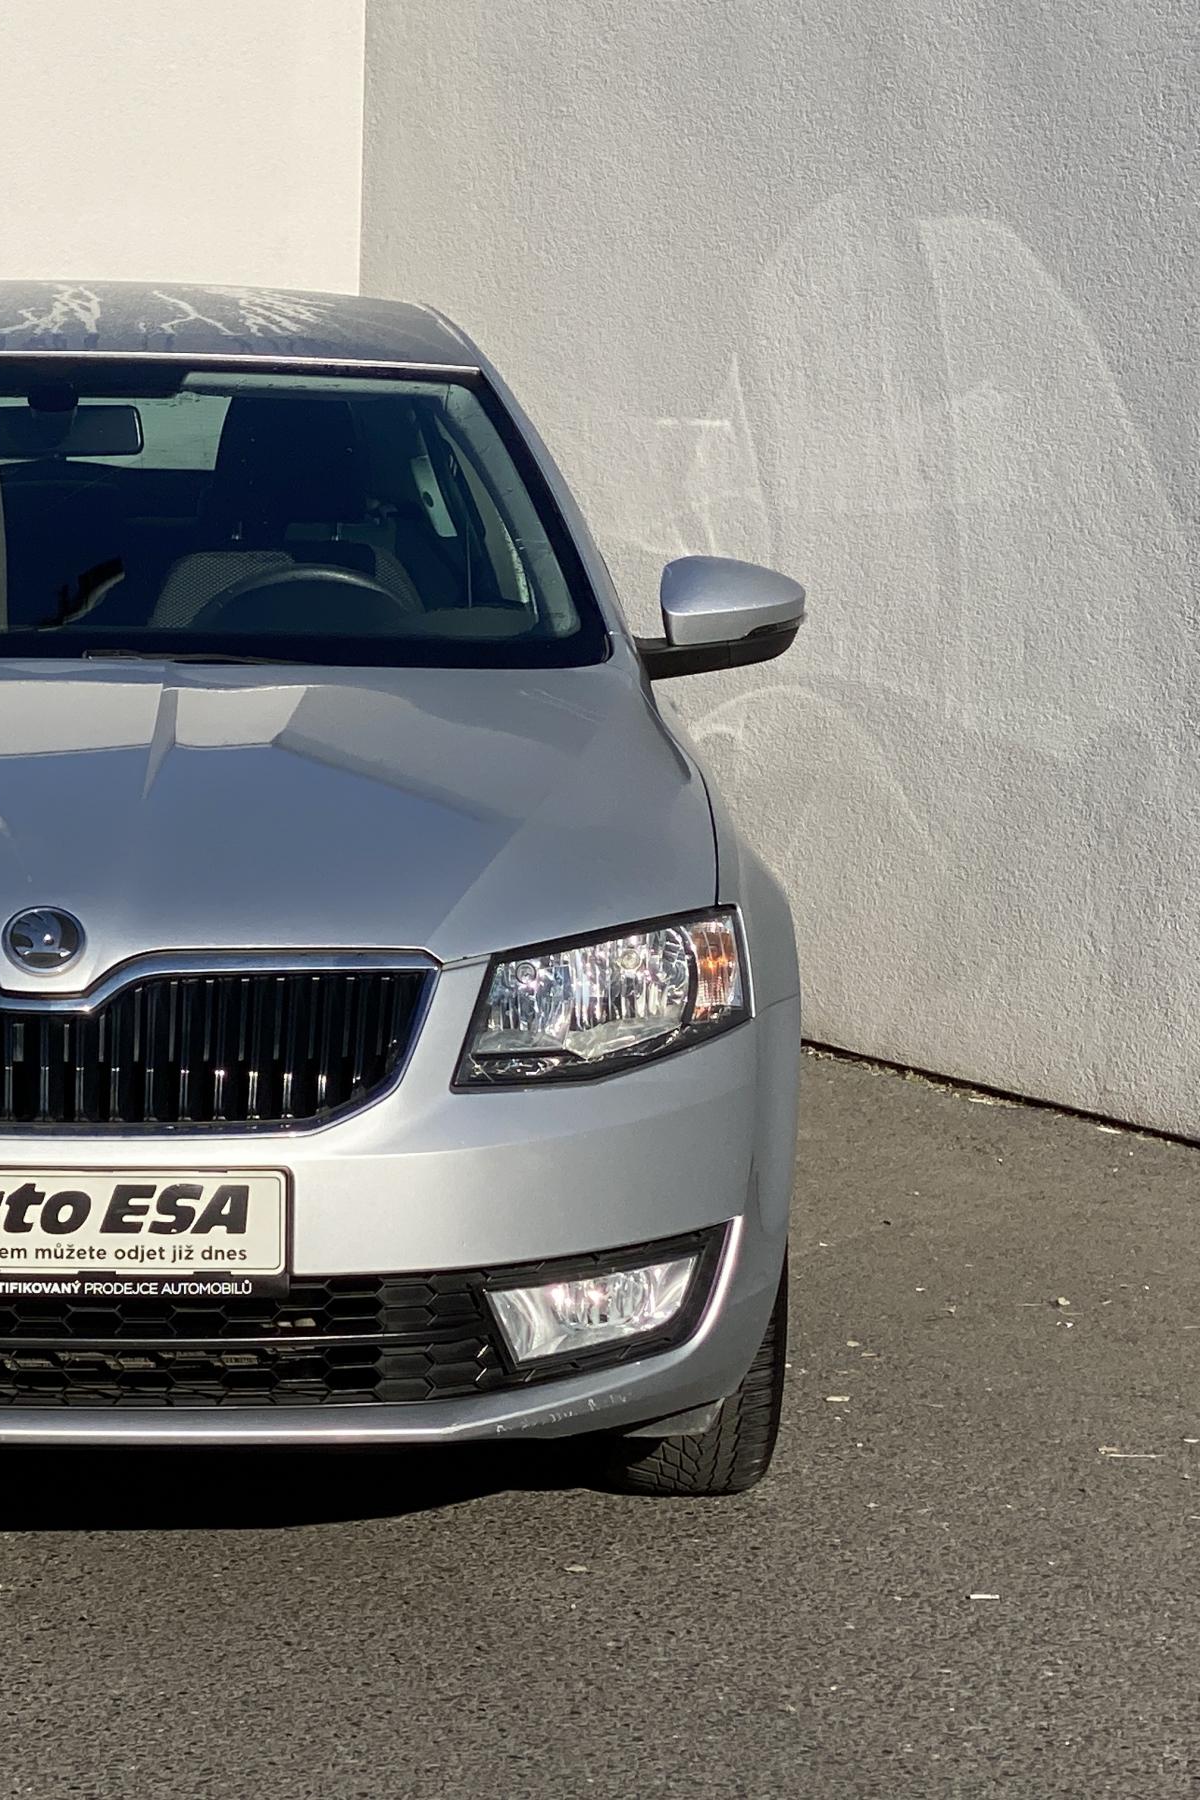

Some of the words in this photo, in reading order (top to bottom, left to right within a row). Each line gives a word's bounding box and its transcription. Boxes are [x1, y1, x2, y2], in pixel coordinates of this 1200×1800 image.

[99, 1183, 250, 1235] ESA
[35, 1242, 107, 1260] můžete
[114, 1245, 166, 1263] odjet
[171, 1244, 194, 1264] již
[201, 1245, 247, 1261] dnes
[84, 1282, 159, 1295] PRODEJCE
[160, 1279, 253, 1295] AUTOMOBILŮ
